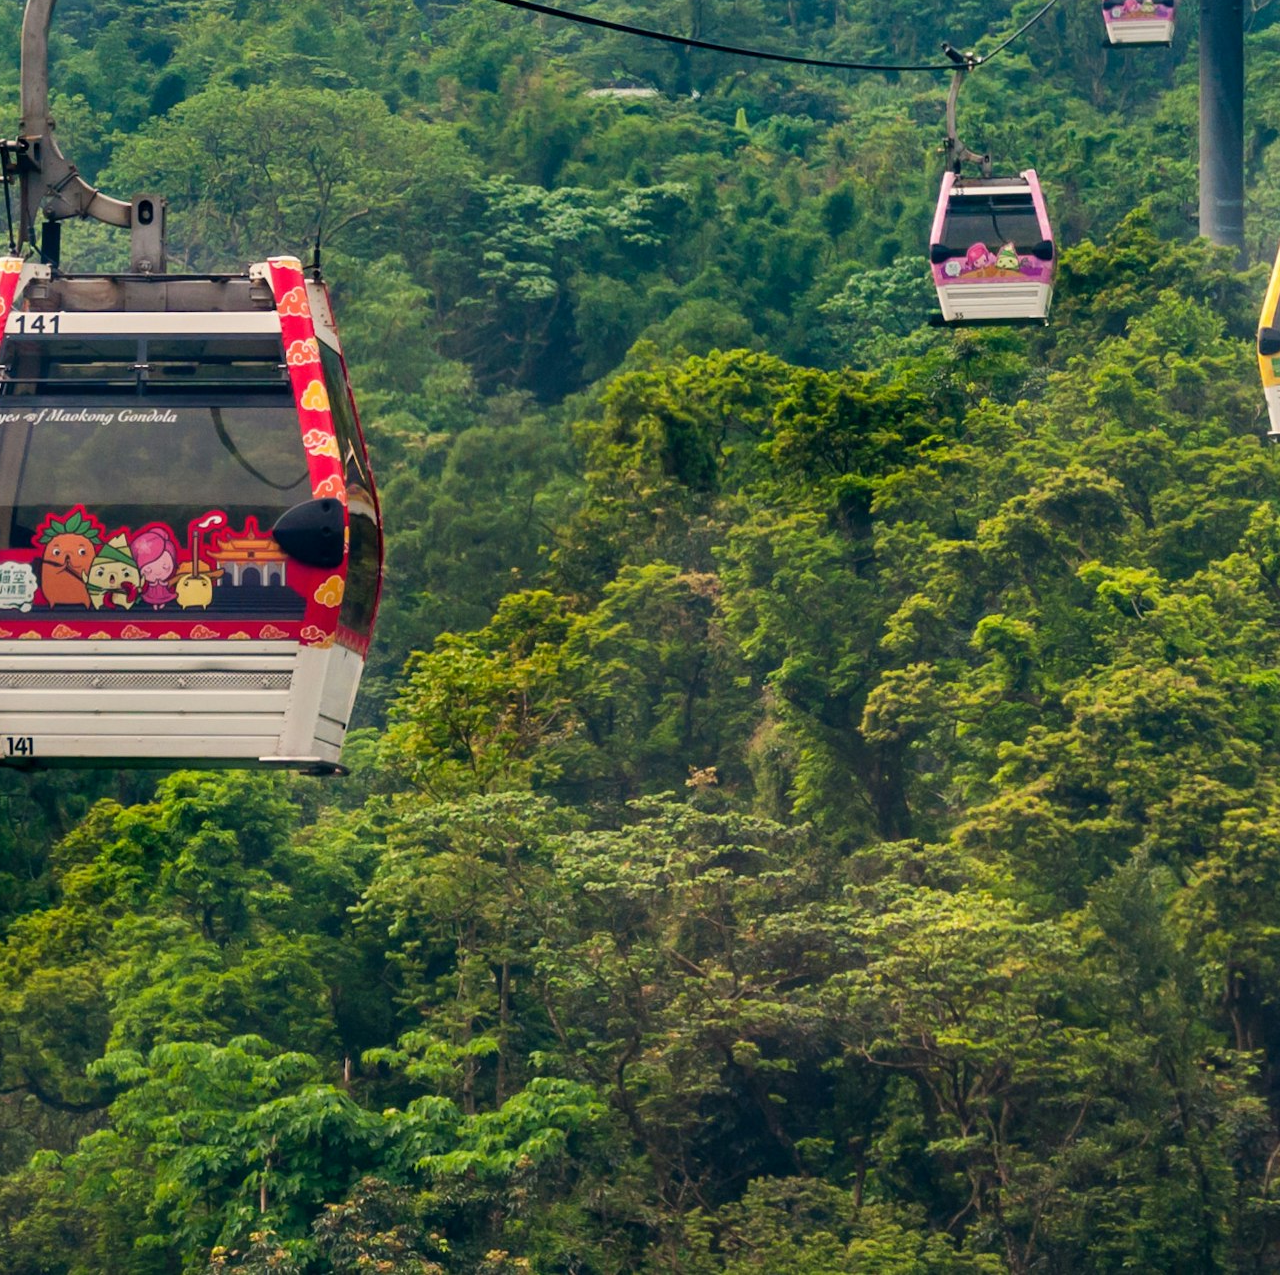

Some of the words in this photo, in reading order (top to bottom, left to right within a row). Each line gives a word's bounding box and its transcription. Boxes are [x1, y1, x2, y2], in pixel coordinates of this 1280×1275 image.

[15, 314, 60, 334] 141
[45, 408, 114, 426] Maokong
[117, 409, 178, 423] Gondola
[6, 736, 34, 756] 141
